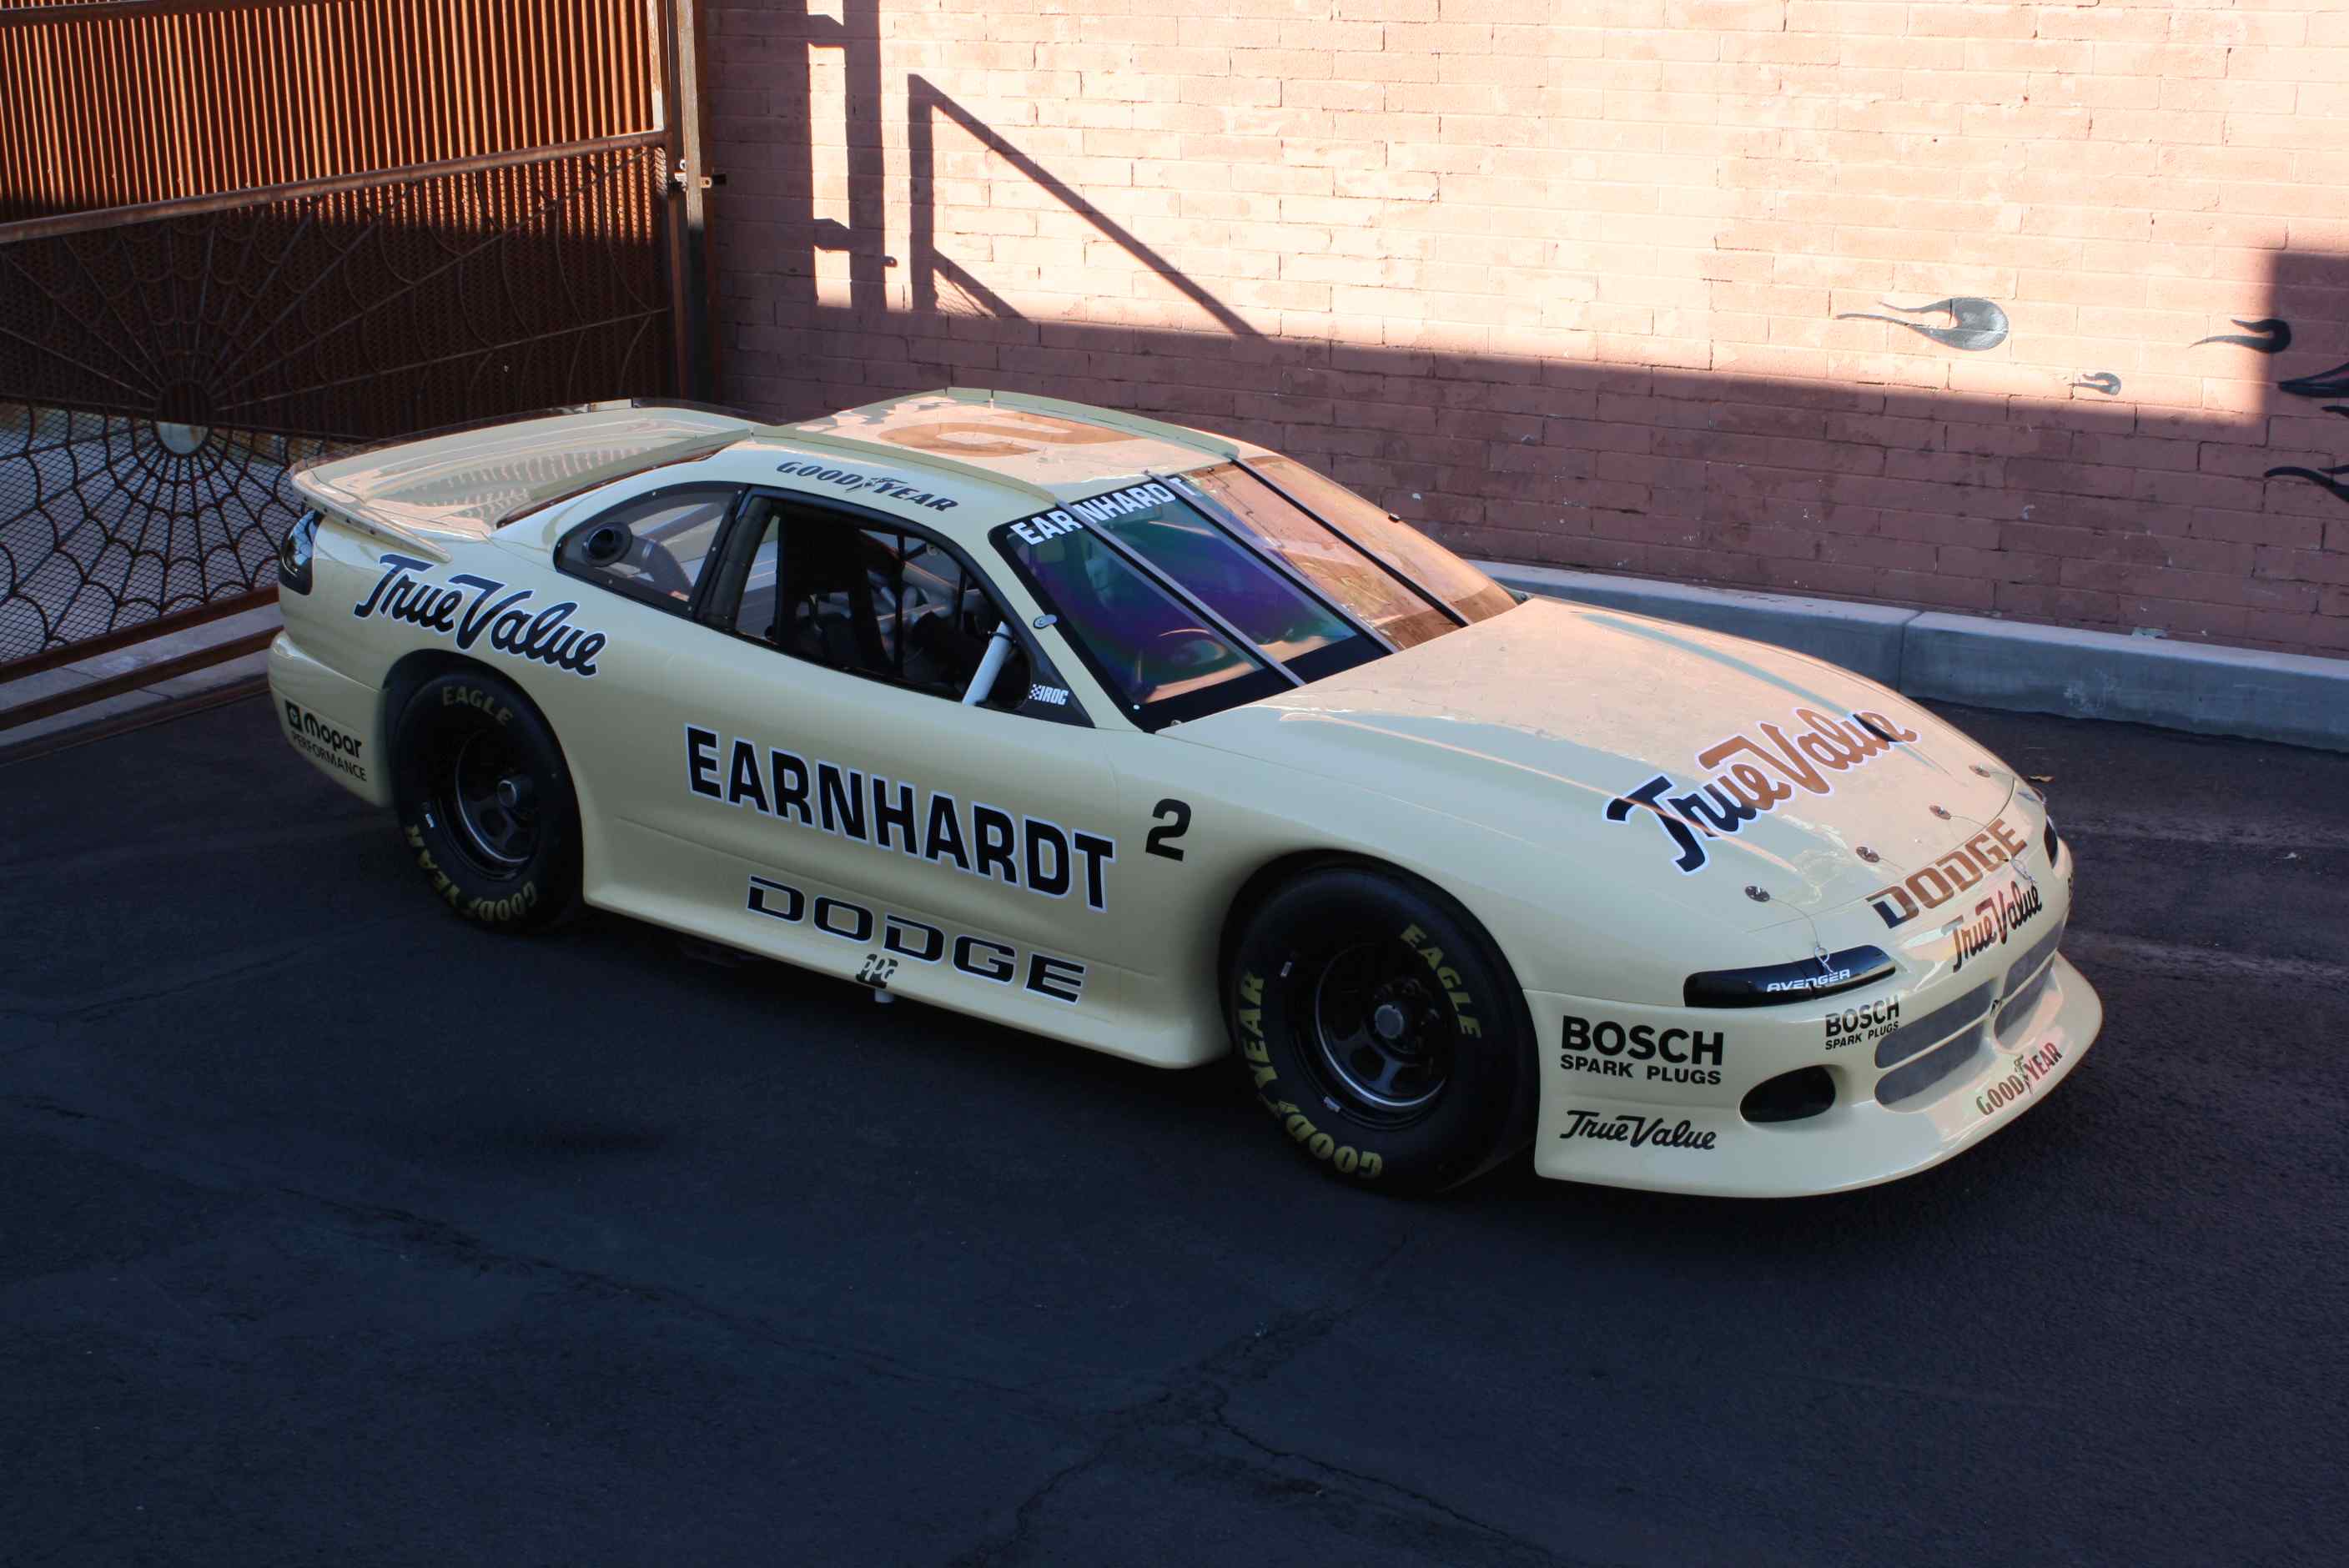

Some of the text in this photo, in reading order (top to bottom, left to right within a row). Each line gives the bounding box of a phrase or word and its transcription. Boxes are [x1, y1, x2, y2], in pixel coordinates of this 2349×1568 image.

[441, 686, 514, 727] EAGLE
[1038, 685, 1069, 706] IROC
[292, 731, 367, 781] PERFORMANCE
[685, 722, 1118, 914] EARNHARDT
[1145, 798, 1192, 862] 2
[1866, 818, 2028, 929] DODGE
[747, 875, 1086, 1006] DODGE
[1400, 923, 1482, 1038] EAGLE
[1562, 1014, 1724, 1066] BOSCH
[1825, 994, 1899, 1038] BOSCH
[1825, 1021, 1899, 1050] SPARK PLUGS
[1560, 1053, 1722, 1085] SPARK PLUGS
